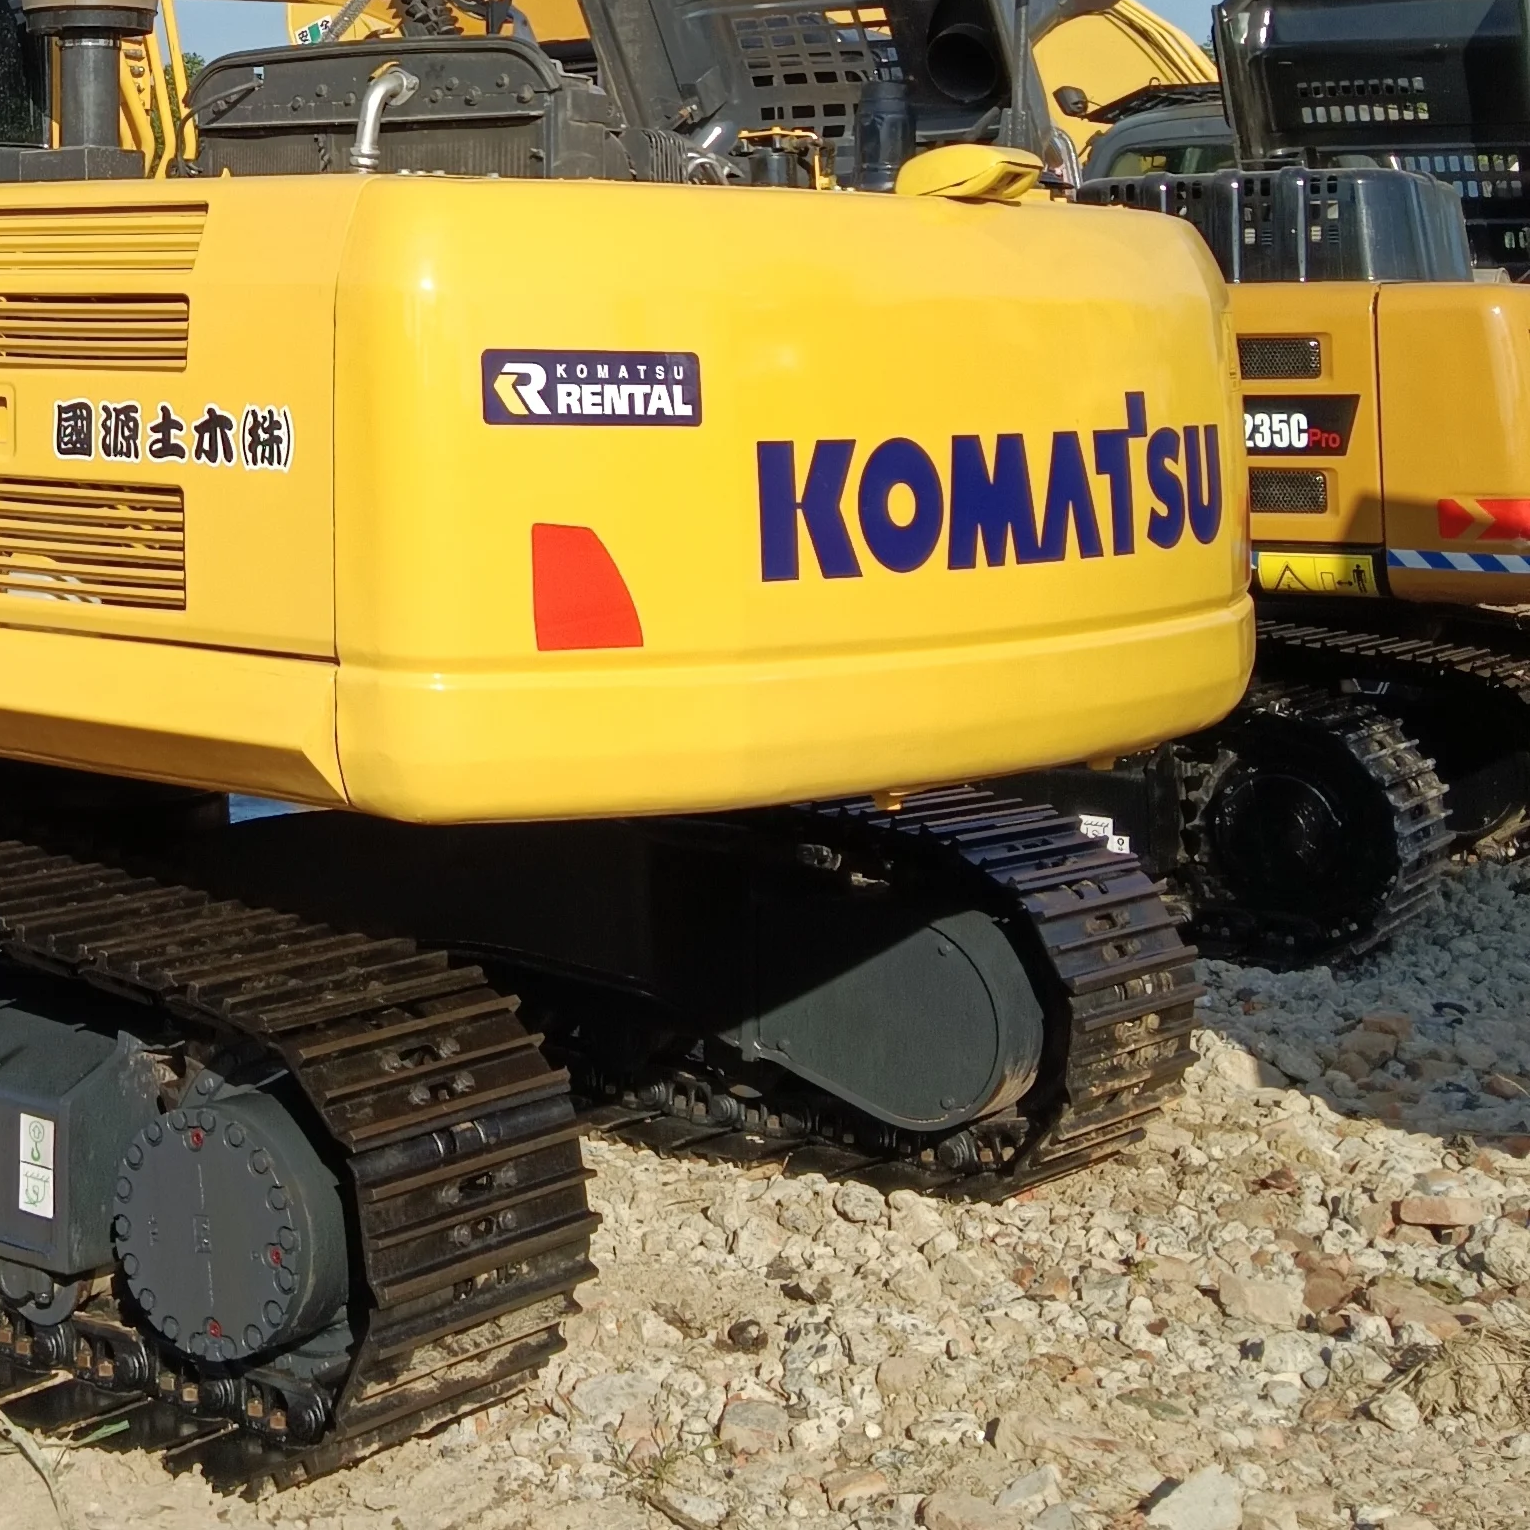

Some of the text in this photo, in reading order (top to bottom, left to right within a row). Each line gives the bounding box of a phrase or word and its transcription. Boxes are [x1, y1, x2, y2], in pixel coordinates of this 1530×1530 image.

[556, 363, 684, 380] KOMATSU
[557, 383, 693, 416] RENTAL
[1309, 428, 1340, 448] Pro
[756, 392, 1222, 582] KOMATSU
